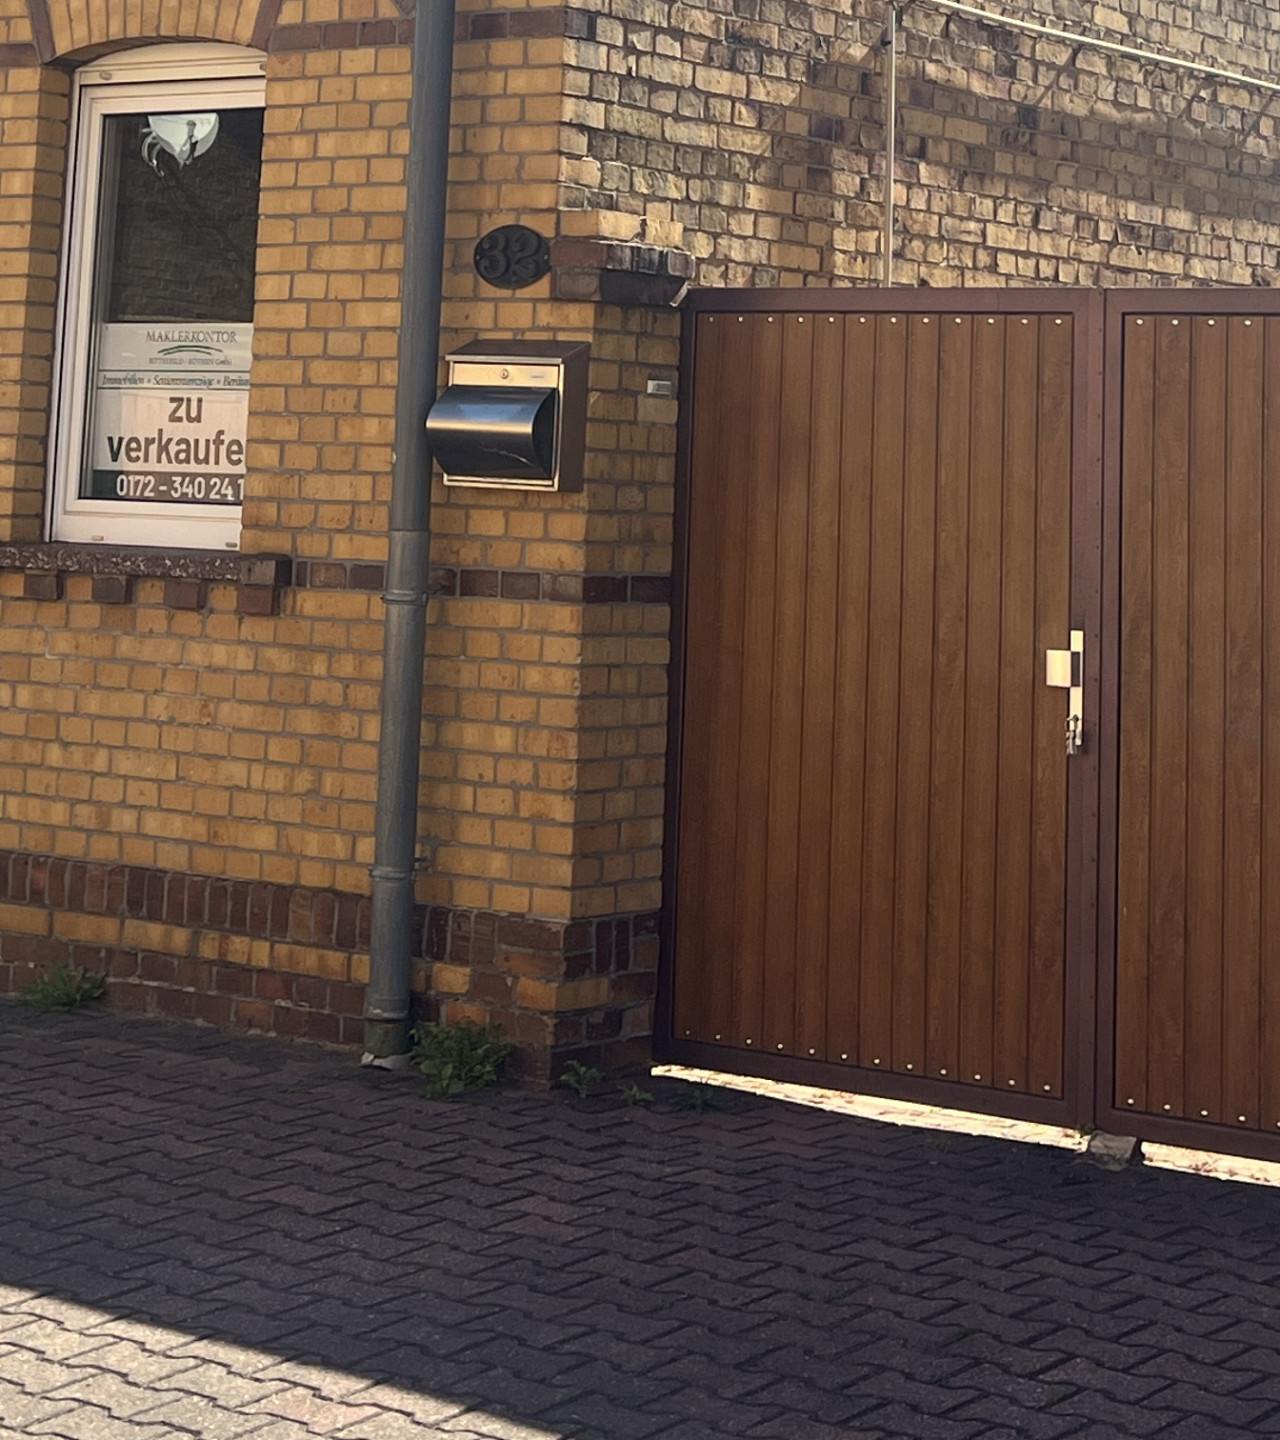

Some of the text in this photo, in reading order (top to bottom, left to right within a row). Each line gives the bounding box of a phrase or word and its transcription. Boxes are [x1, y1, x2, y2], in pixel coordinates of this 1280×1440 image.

[145, 330, 238, 344] MAKLERKONTOR
[168, 397, 203, 423] zu
[107, 428, 244, 466] verkaufe
[116, 474, 155, 497] 0172
[170, 476, 206, 498] 340
